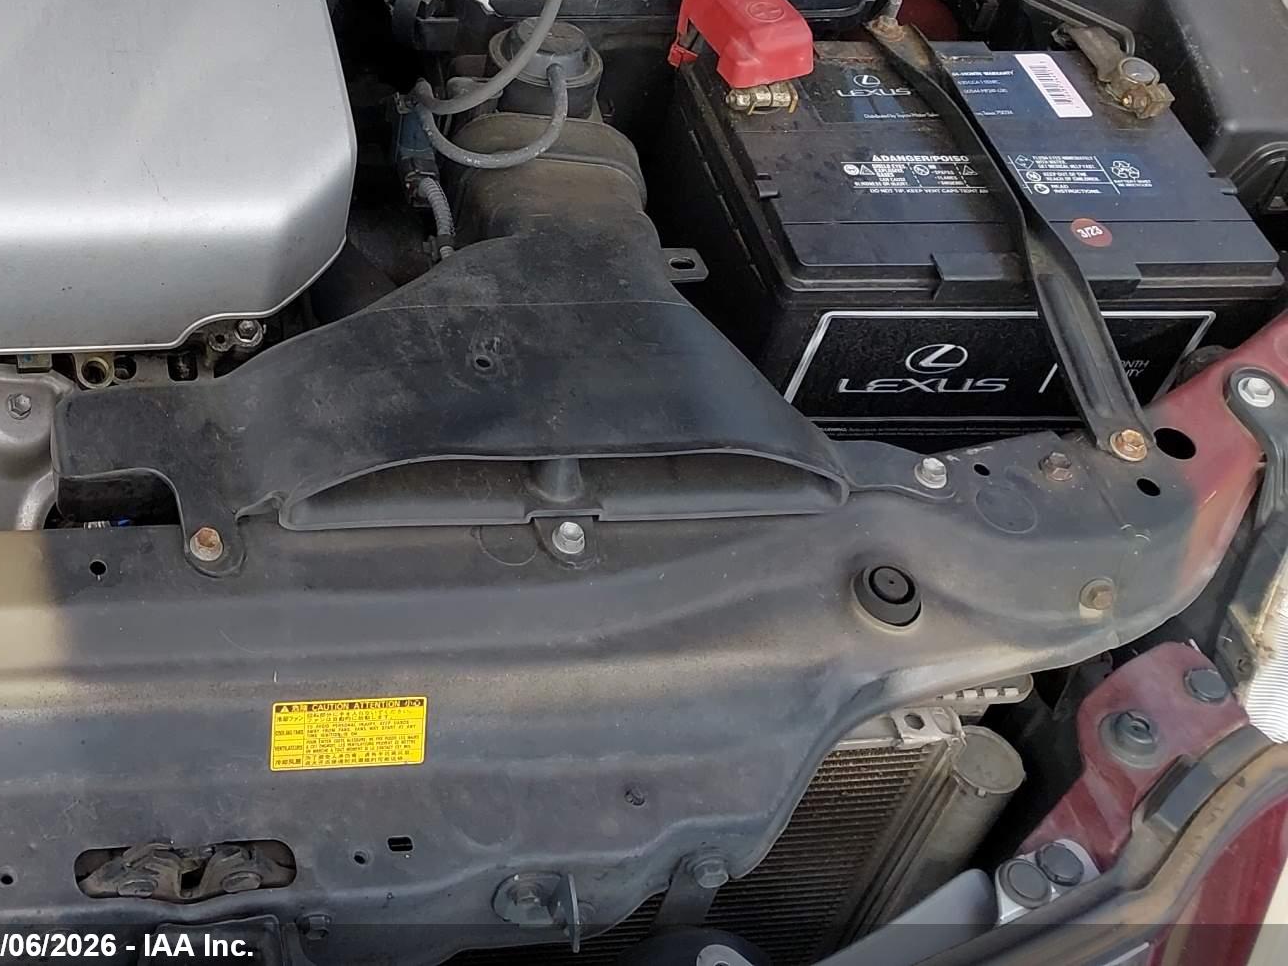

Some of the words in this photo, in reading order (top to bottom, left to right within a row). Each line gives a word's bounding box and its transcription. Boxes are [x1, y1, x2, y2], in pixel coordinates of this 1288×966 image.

[836, 87, 912, 98] LEXUS
[881, 154, 969, 162] DANGER/POISO
[1076, 225, 1103, 238] 3/23
[837, 378, 1010, 394] LEXUS
[312, 702, 350, 712] CAUTION
[354, 700, 401, 710] ATTENTION
